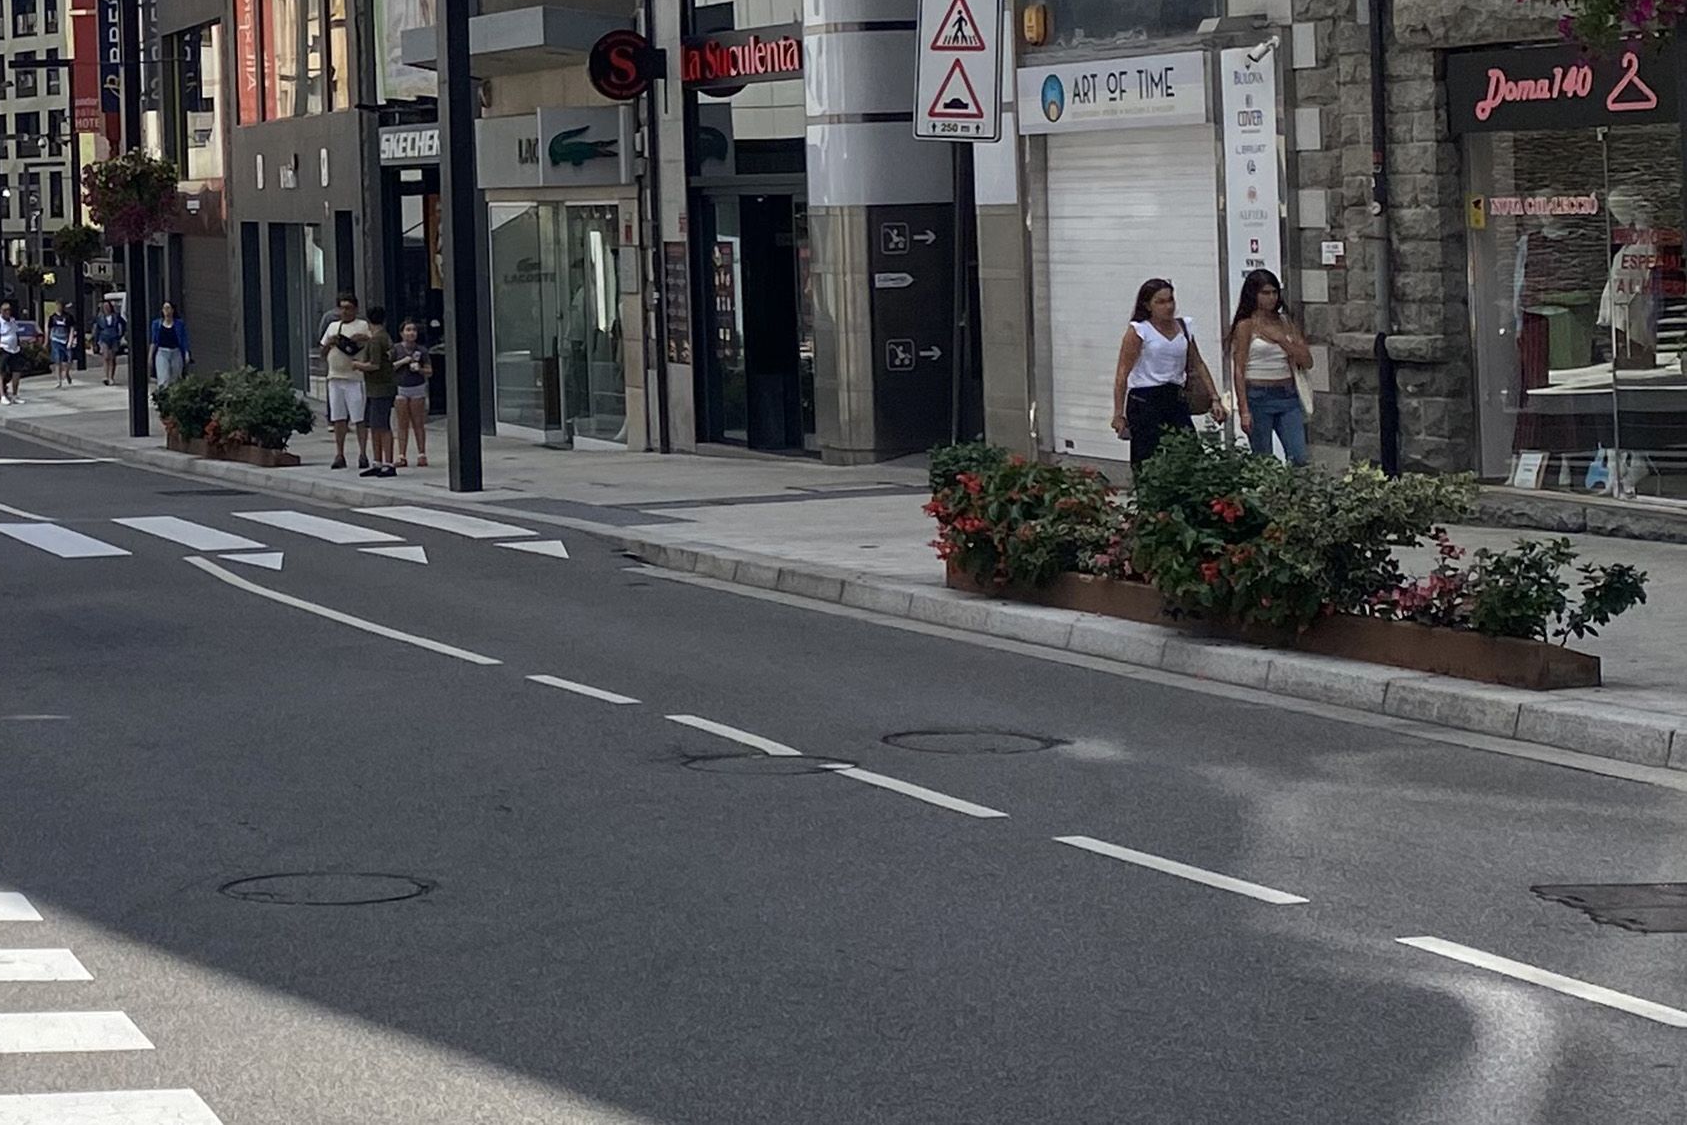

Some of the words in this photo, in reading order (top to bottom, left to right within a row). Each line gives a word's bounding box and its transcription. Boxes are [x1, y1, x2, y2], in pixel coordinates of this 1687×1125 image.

[609, 45, 637, 84] S
[705, 34, 802, 80] Suculenta
[1072, 73, 1098, 105] ART
[1106, 71, 1127, 102] OF
[1137, 67, 1175, 100] TIME
[380, 129, 441, 159] SKECHER
[940, 123, 959, 132] 250
